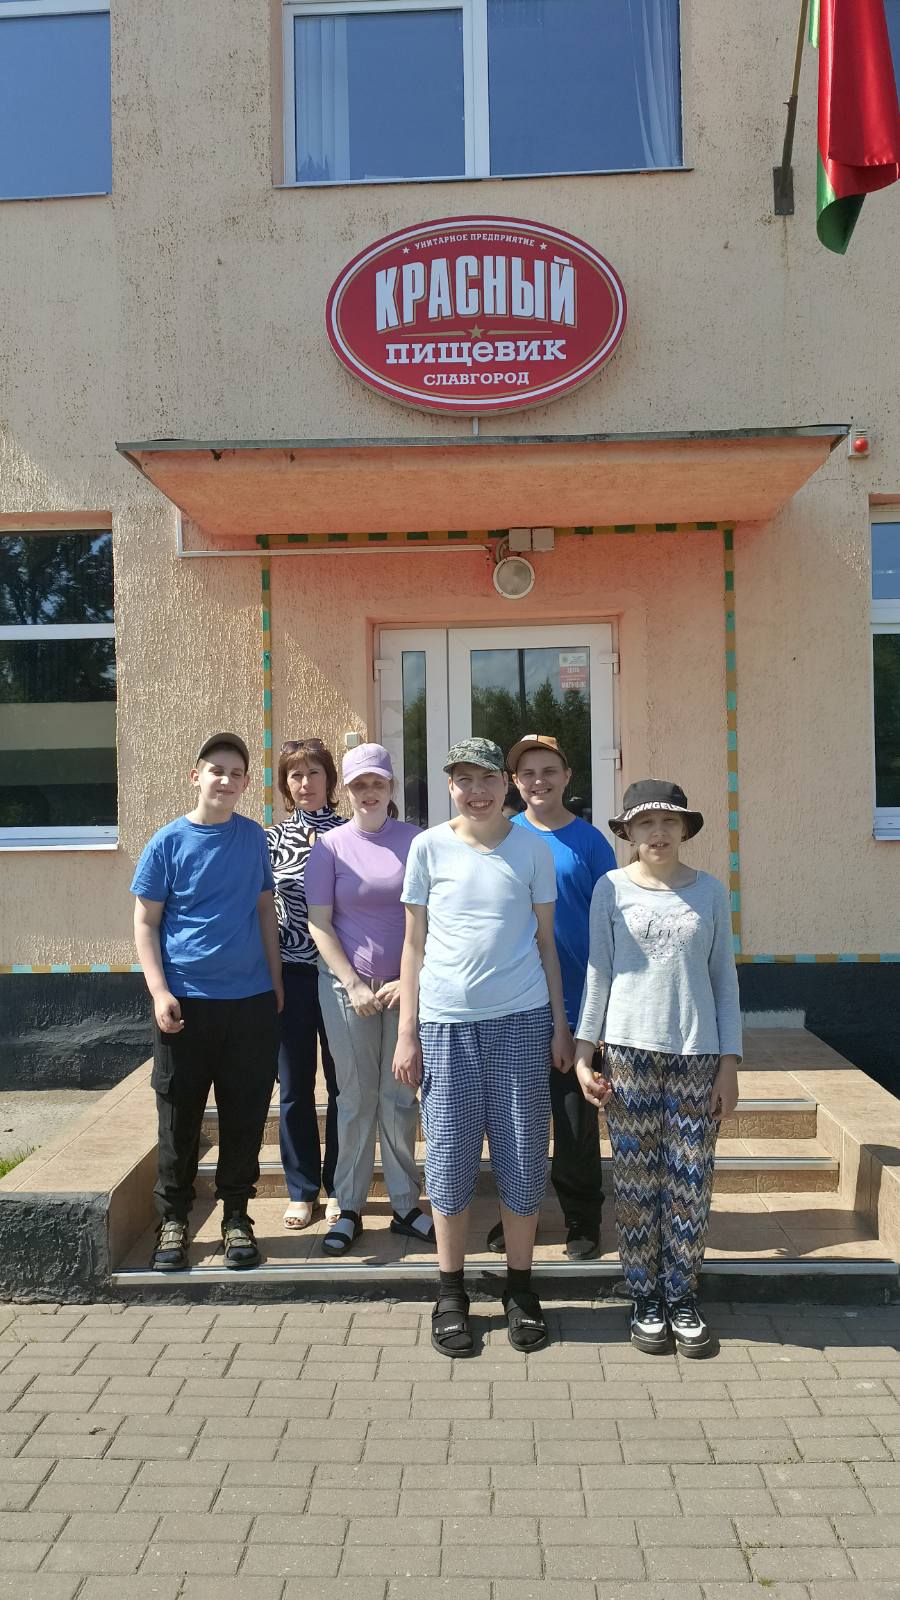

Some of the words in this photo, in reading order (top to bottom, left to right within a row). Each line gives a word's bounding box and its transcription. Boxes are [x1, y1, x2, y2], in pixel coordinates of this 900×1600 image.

[414, 233, 468, 250] УНИТАРНОЕ
[470, 233, 536, 247] ПРЕДПРИЯТИЕ
[375, 255, 577, 332] КРАСНЫЙ
[423, 371, 530, 386] СЛАВГОРОД
